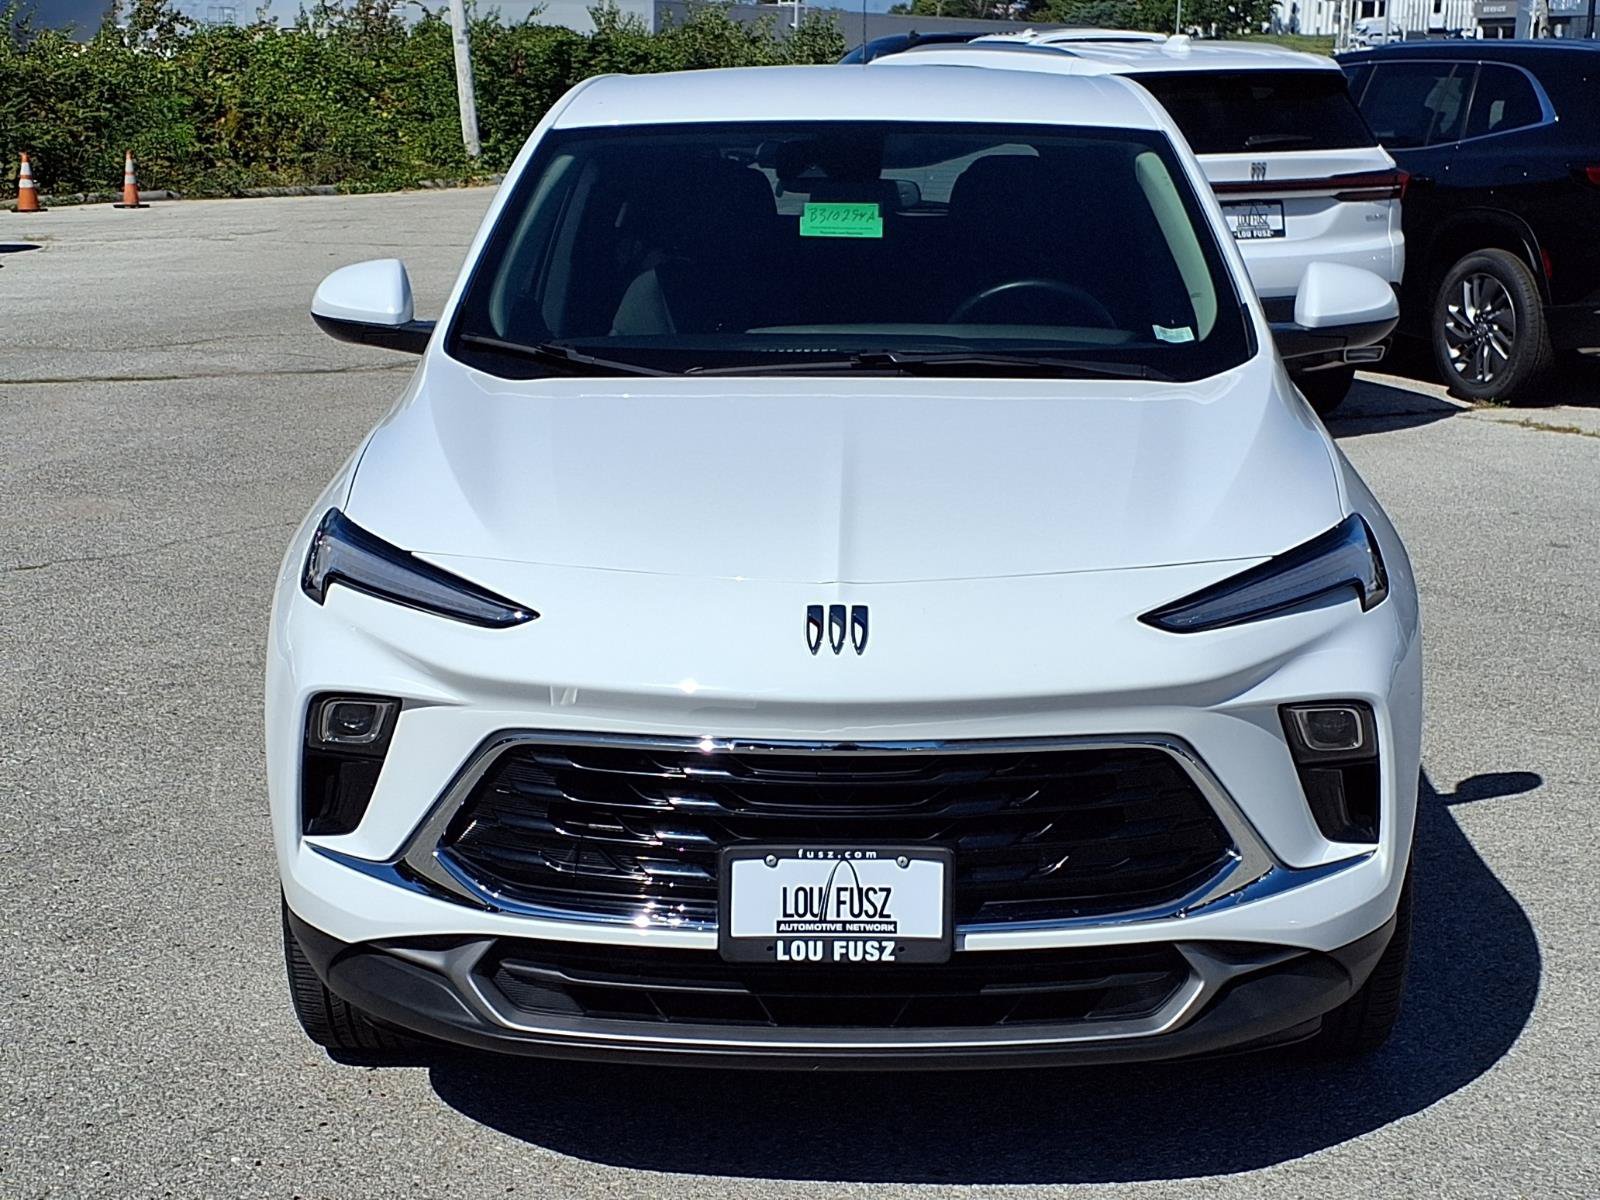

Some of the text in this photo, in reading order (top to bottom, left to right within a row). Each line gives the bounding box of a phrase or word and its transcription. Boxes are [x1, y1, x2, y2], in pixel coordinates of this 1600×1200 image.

[798, 848, 877, 859] fusz.com
[782, 886, 892, 919] LOU FUSZ
[779, 923, 895, 932] AUTOMOTIVE NETWORK
[776, 940, 895, 962] LOU FUSZ
